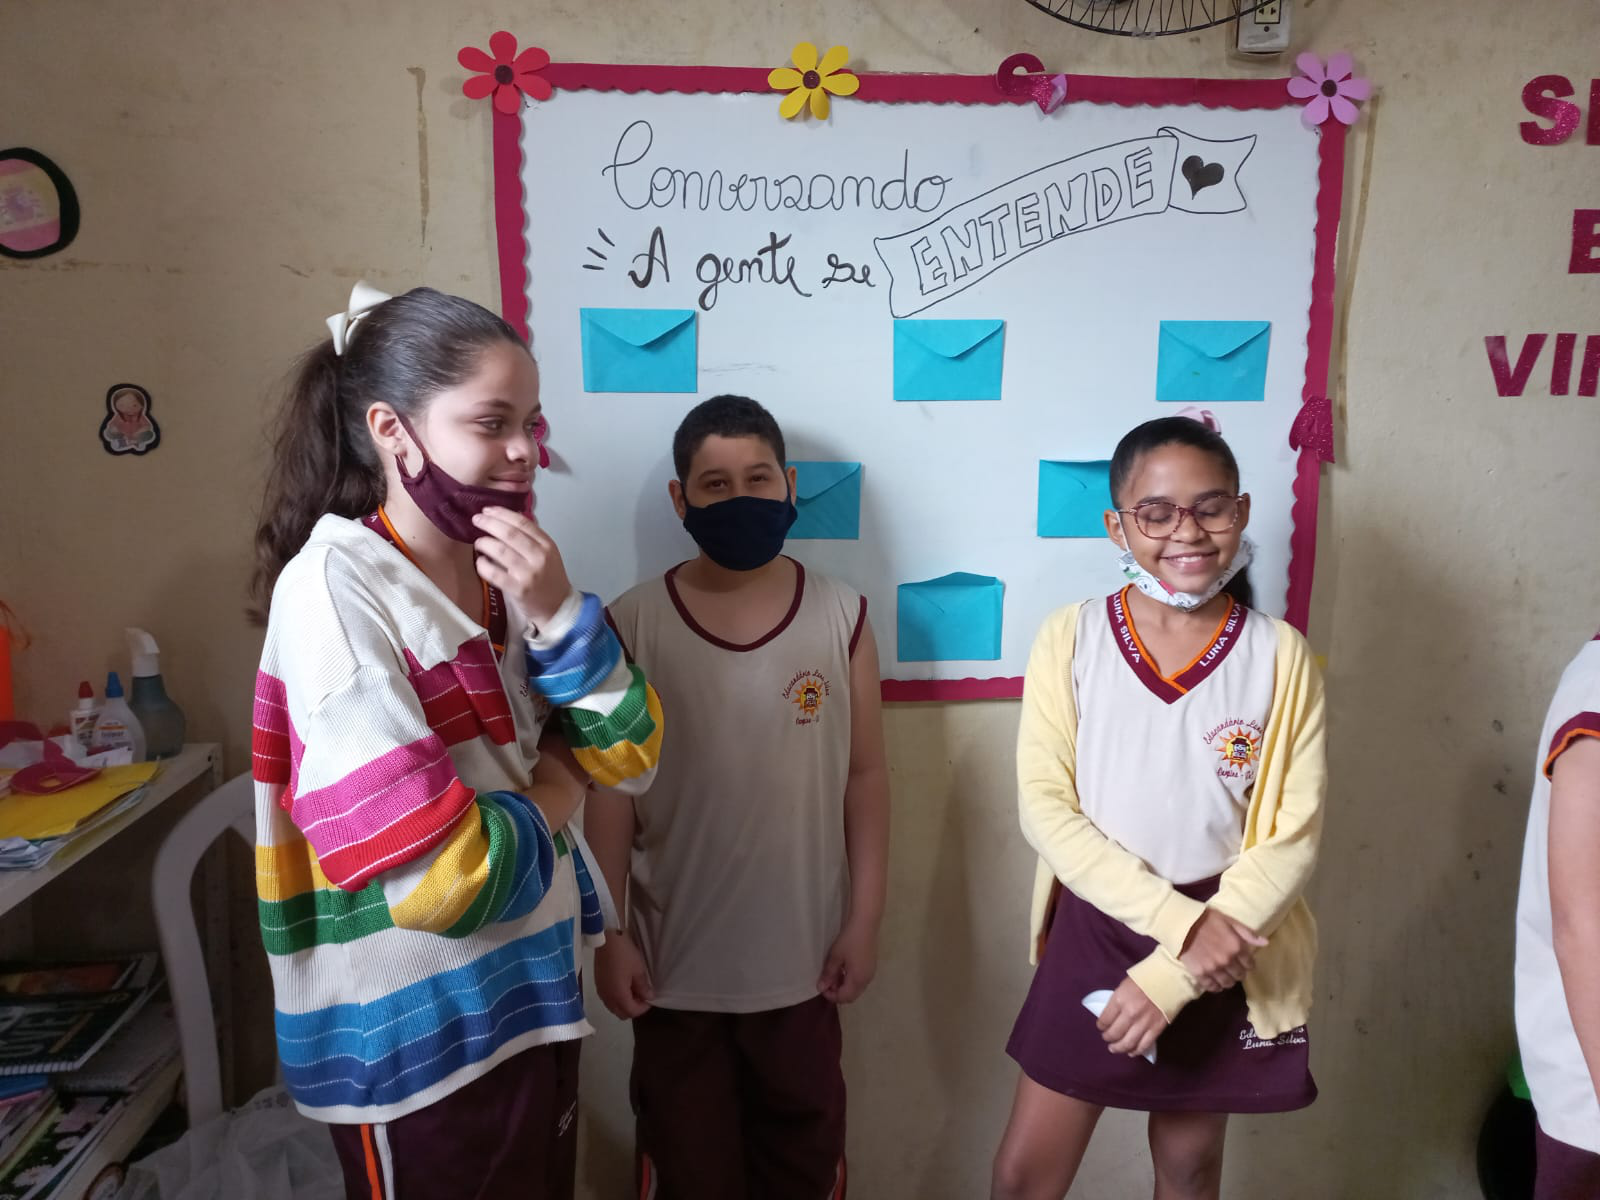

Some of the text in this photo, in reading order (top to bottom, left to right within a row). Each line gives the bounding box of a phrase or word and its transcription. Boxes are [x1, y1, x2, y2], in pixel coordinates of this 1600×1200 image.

[601, 119, 953, 212] Conversando
[628, 146, 1154, 311] A gente se ENTENDE
[1113, 594, 1141, 663] LUNA SILVA
[1199, 603, 1241, 667] LUNA SILVA
[1242, 1039, 1275, 1050] Luna
